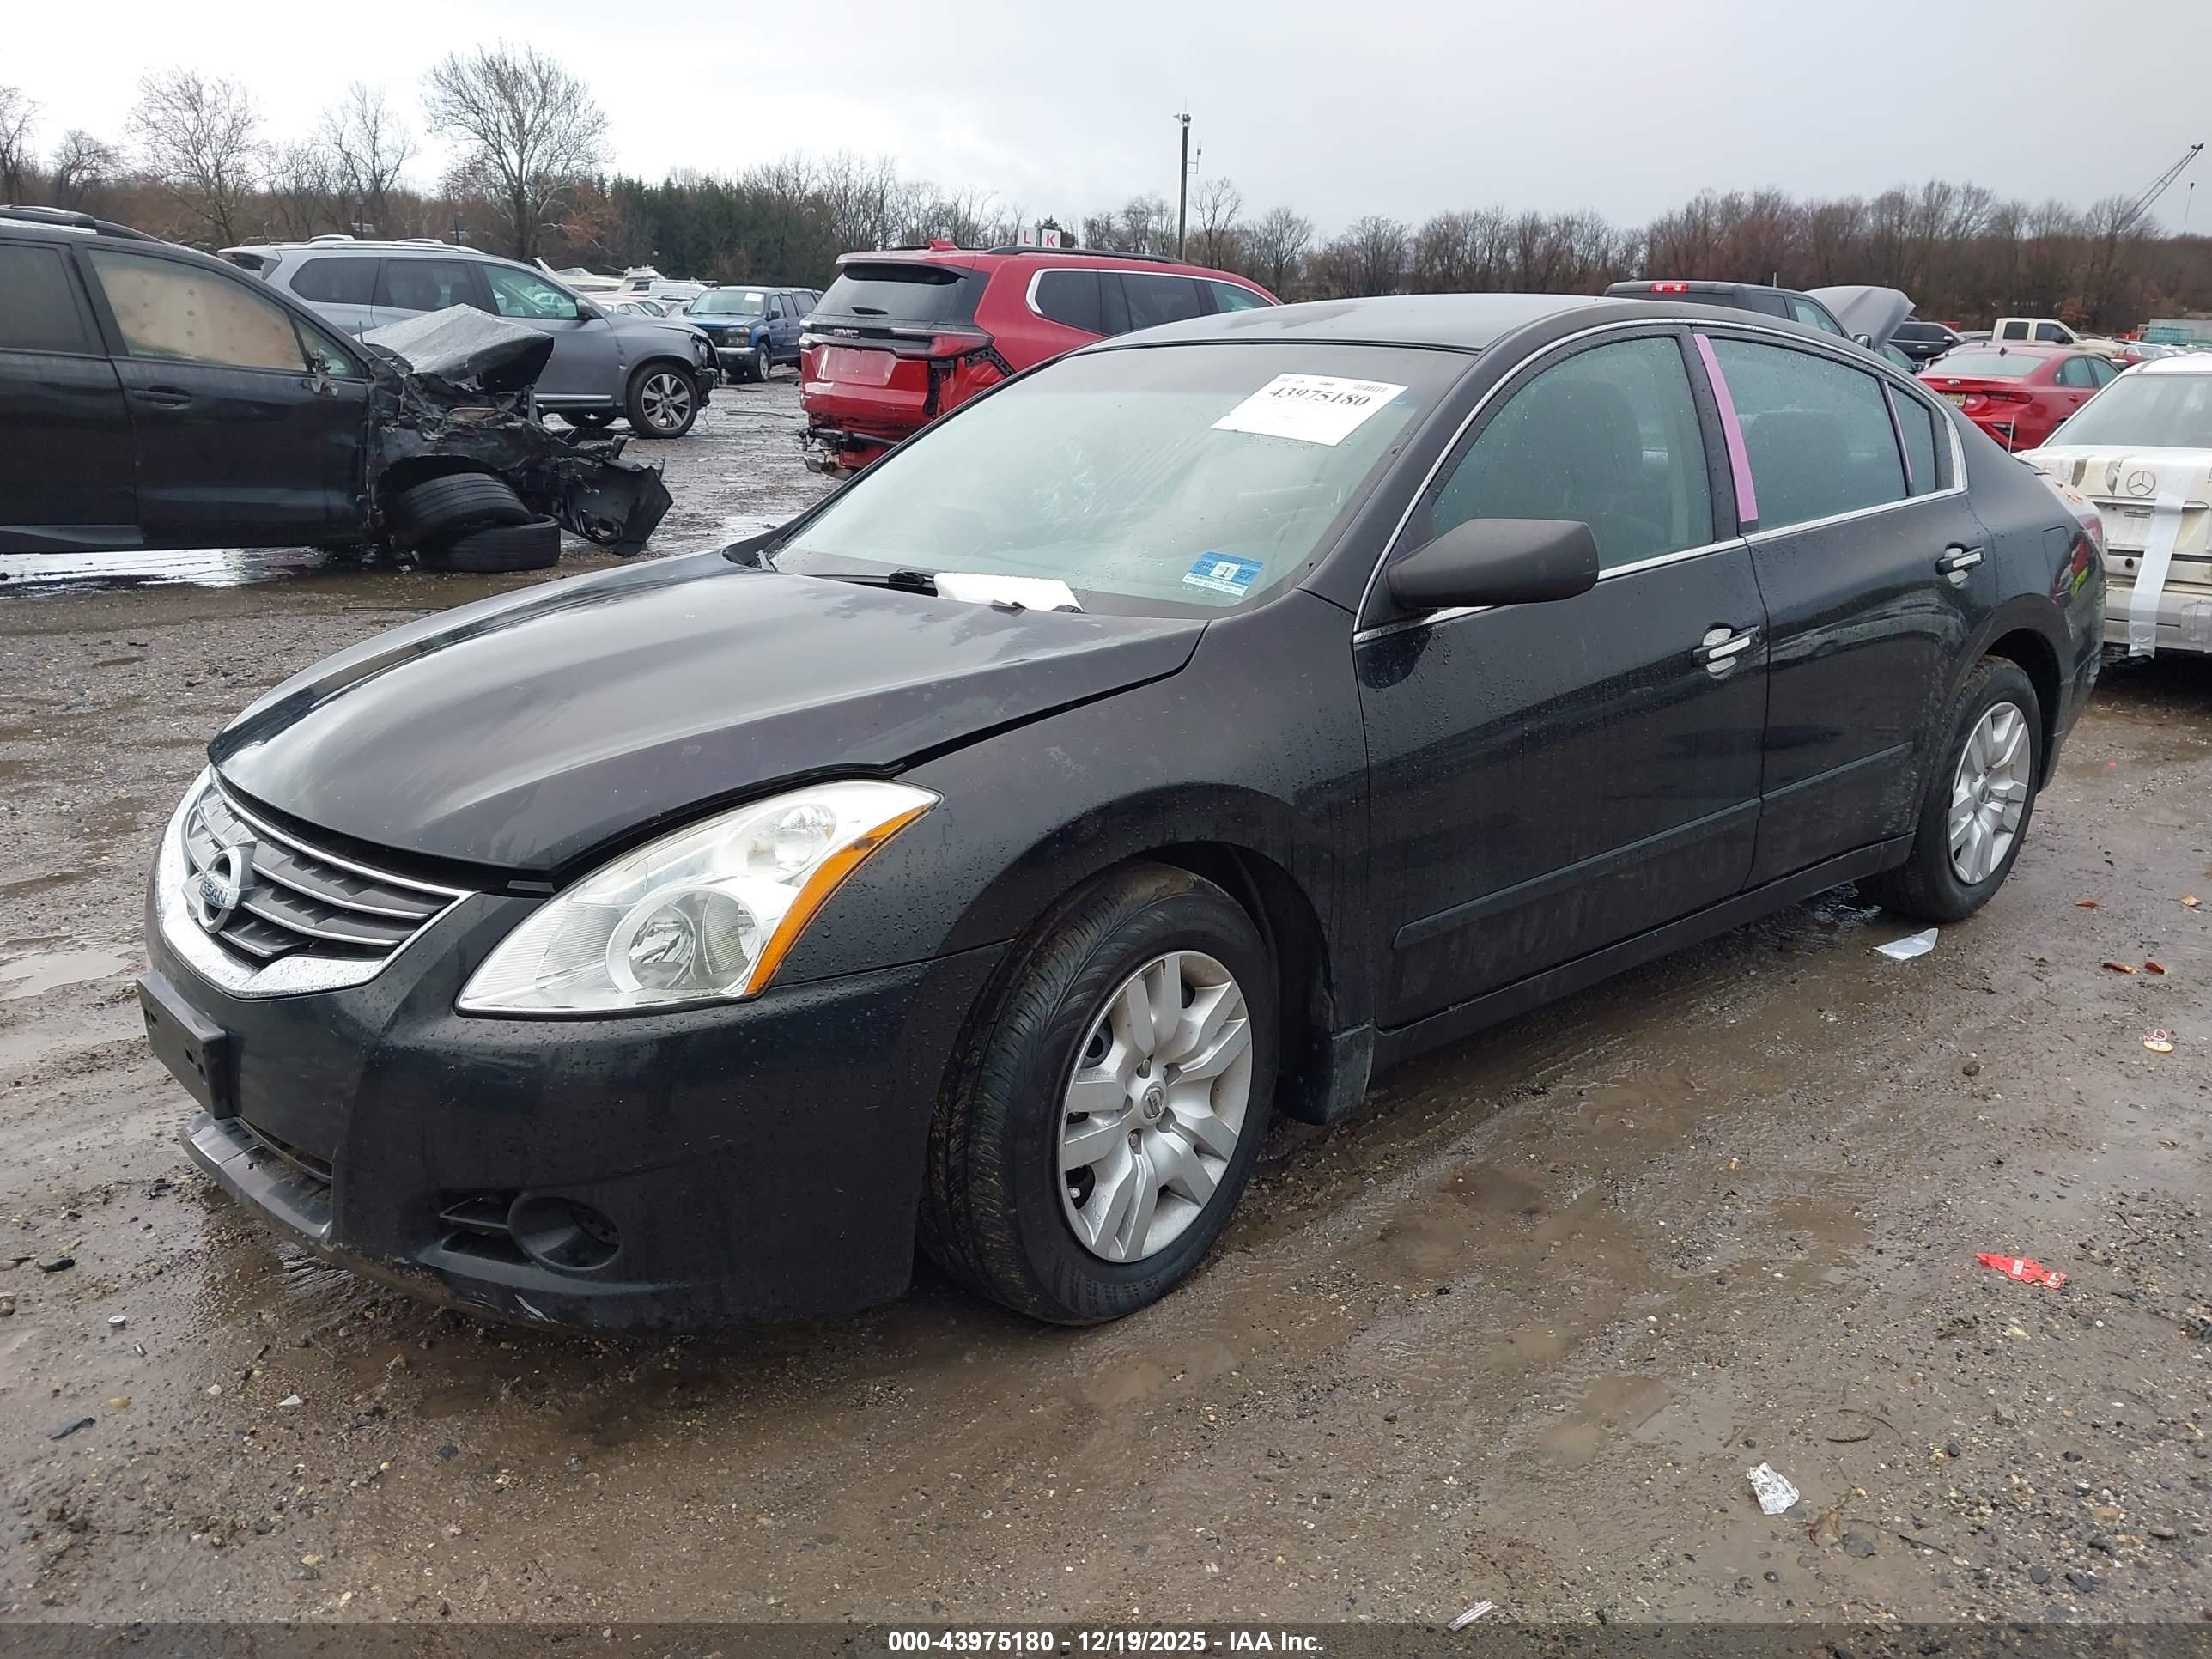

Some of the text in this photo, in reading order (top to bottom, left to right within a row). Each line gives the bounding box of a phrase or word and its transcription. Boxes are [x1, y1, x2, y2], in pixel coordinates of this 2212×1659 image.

[1023, 230, 1031, 245] L
[1046, 233, 1056, 248] K
[1268, 386, 1372, 406] 43975180
[1220, 567, 1231, 577] 1
